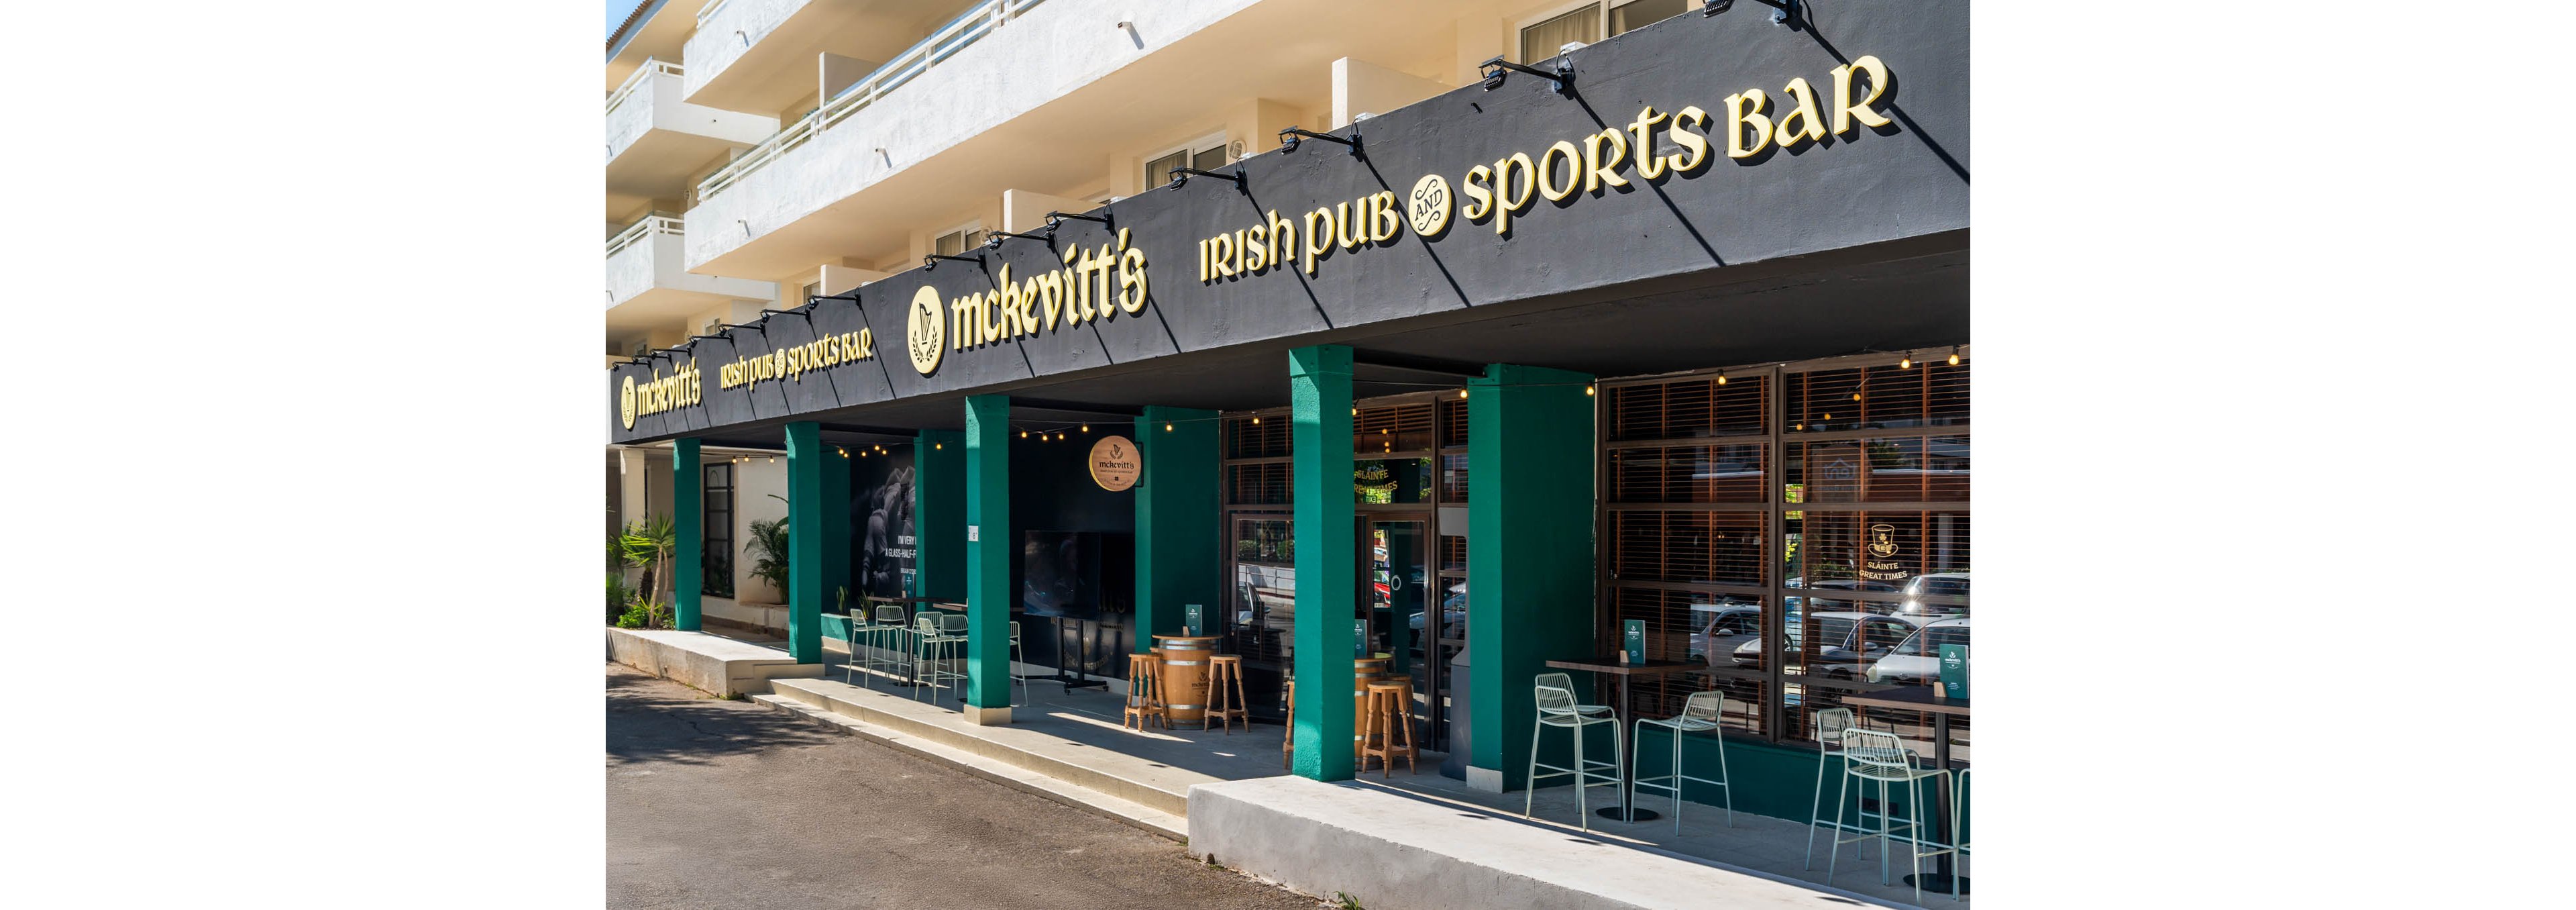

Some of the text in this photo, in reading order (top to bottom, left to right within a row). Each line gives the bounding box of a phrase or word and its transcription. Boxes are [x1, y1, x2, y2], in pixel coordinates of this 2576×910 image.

[1304, 191, 1399, 274] PUB
[1415, 189, 1443, 221] AND
[1463, 106, 1706, 234] SPORTS
[1725, 56, 1891, 158] BAR
[841, 326, 873, 362] BAR
[885, 548, 889, 557] A
[1867, 561, 1899, 570] SLÁINTE
[1859, 570, 1908, 580] GREAT TIMES
